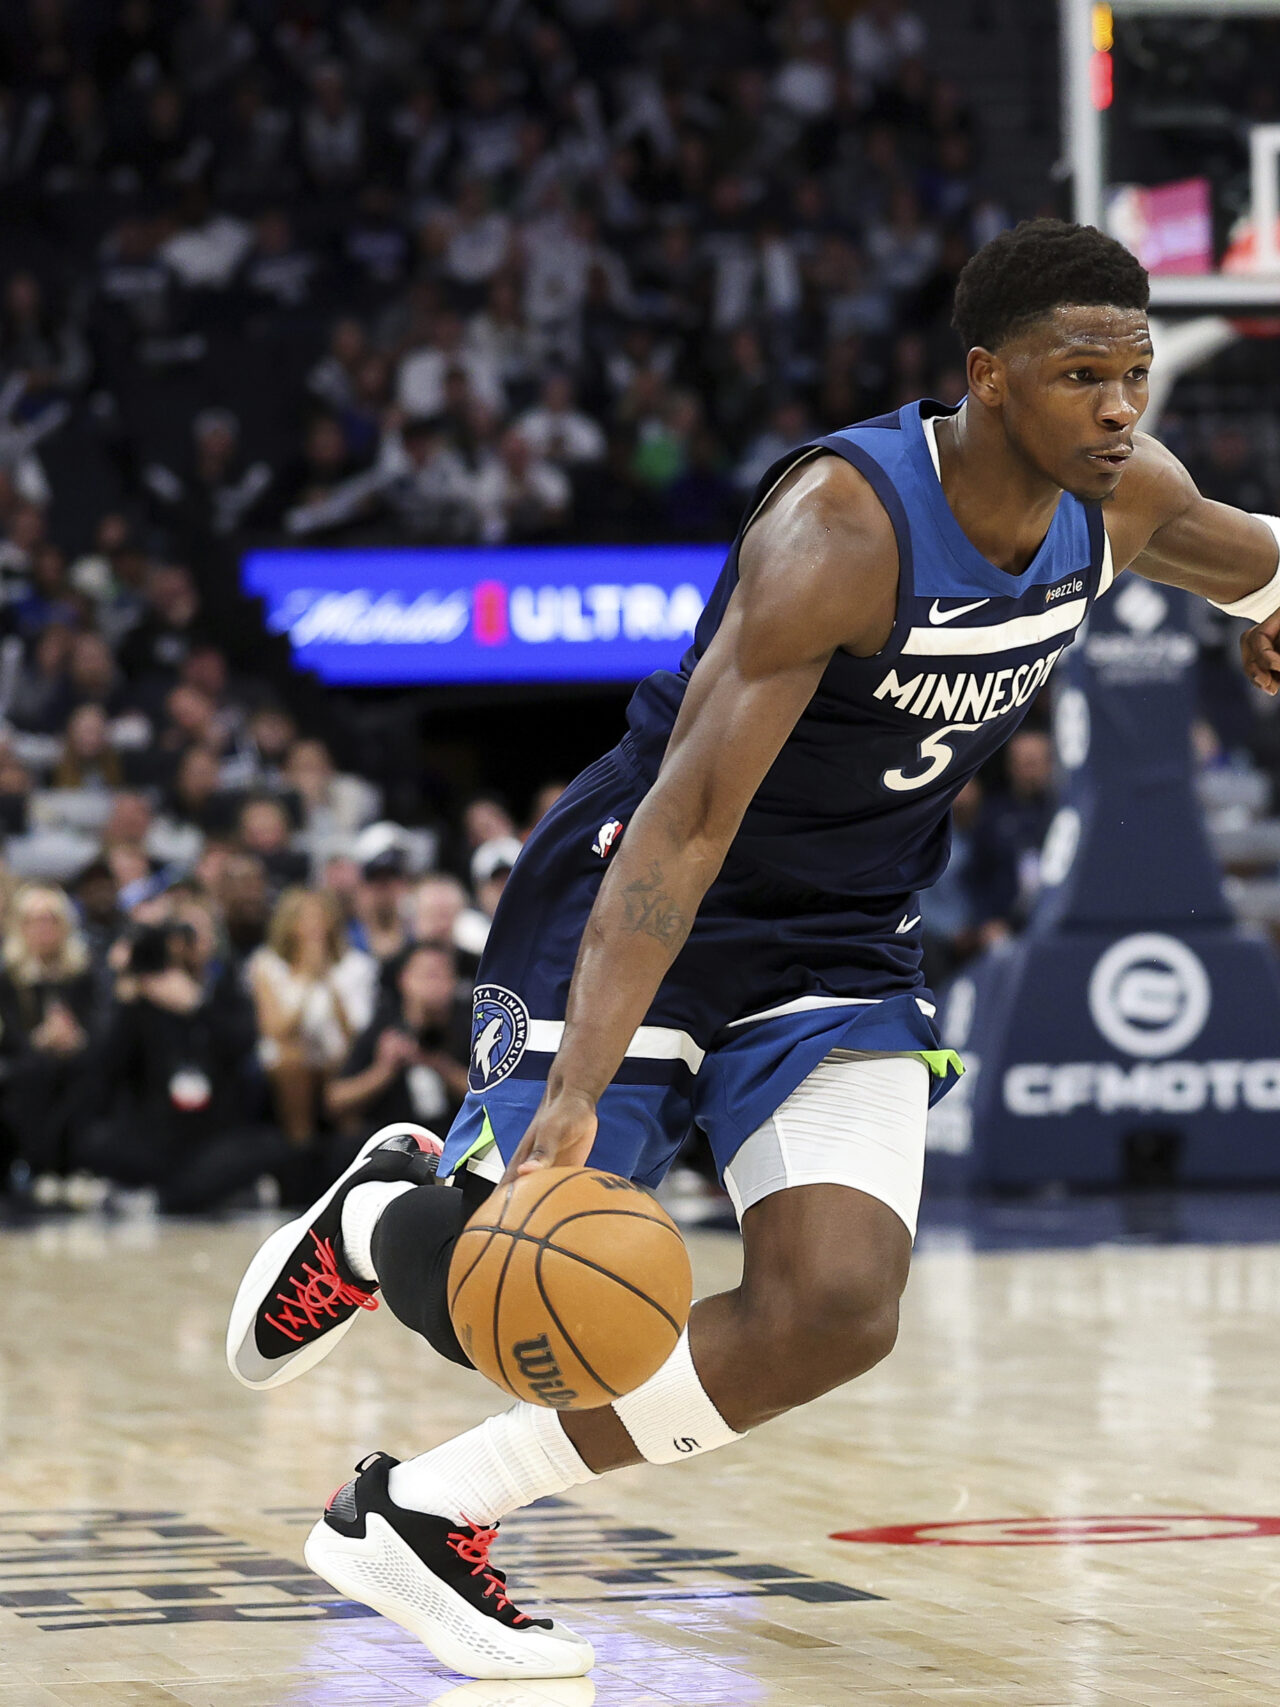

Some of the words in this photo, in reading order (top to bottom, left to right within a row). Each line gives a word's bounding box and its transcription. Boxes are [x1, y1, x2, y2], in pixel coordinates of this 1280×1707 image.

[509, 582, 706, 644] ULTRA
[1050, 577, 1083, 600] sezzle
[872, 643, 1065, 723] MINNESOT
[883, 722, 984, 792] 5
[496, 992, 526, 1078] TIMBERWOLVES
